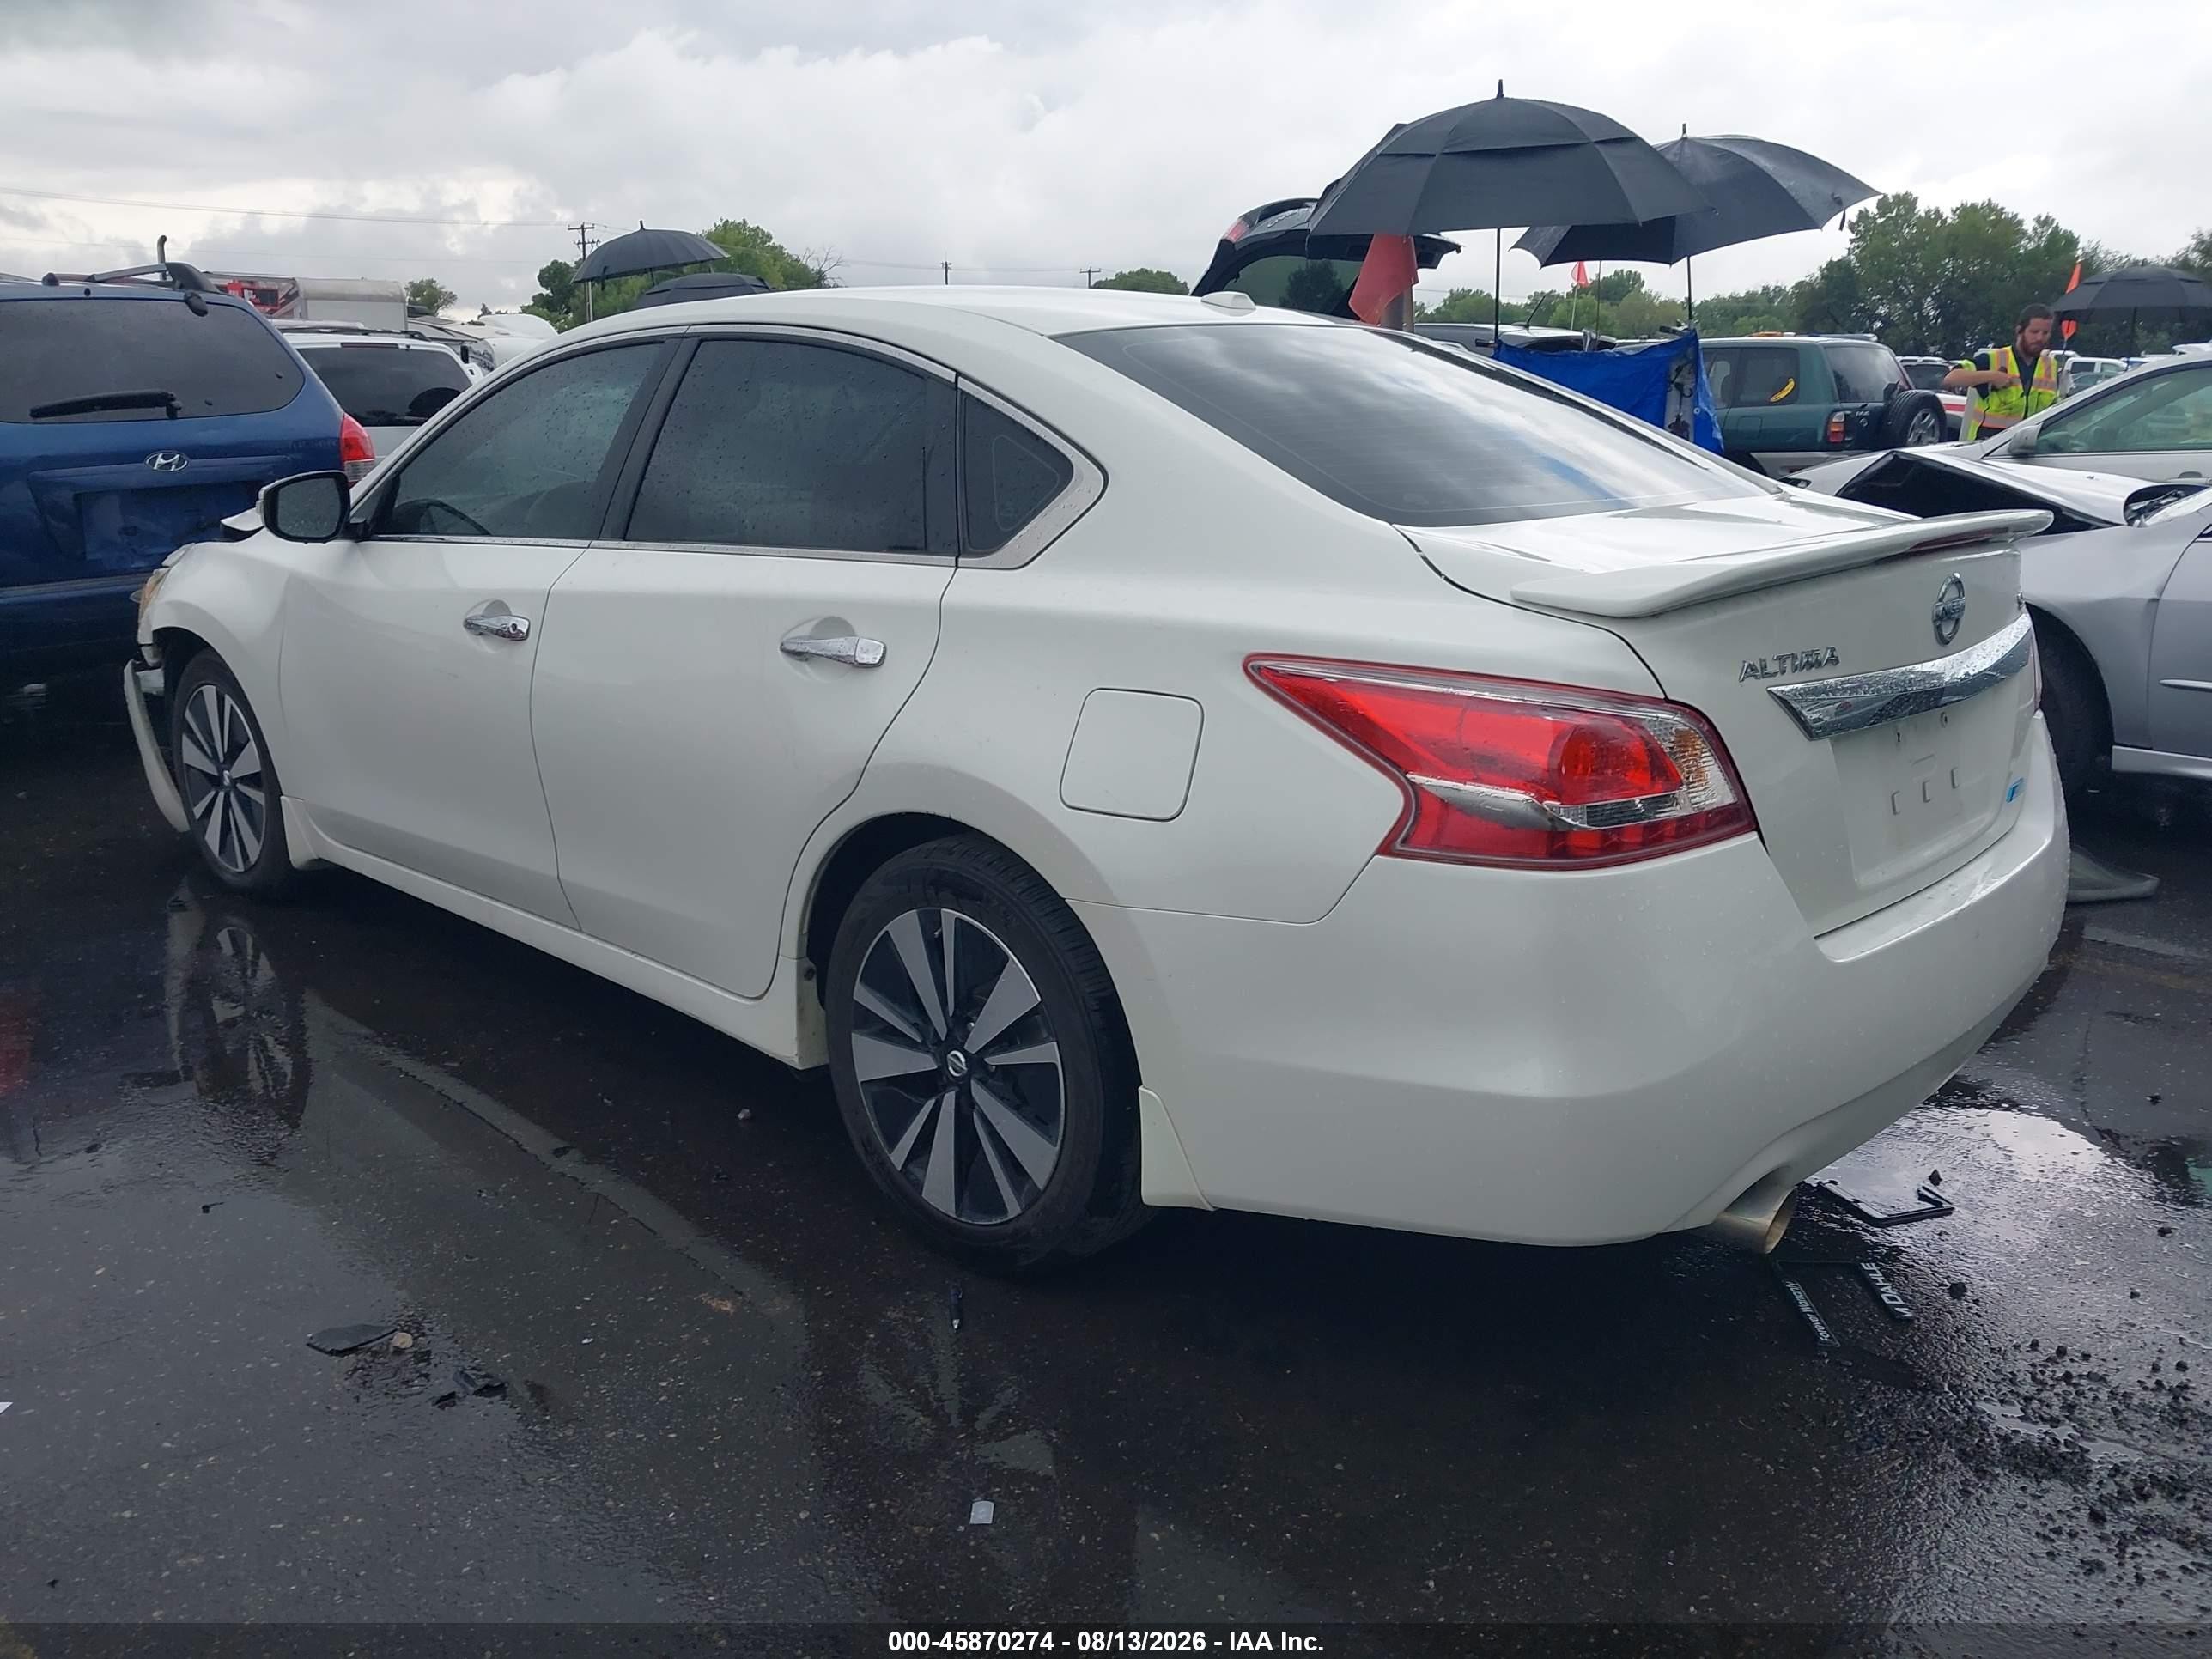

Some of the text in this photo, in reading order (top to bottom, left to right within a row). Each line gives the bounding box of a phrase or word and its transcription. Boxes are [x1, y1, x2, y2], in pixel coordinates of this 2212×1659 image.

[1738, 646, 1840, 683] ALTIMA
[1860, 1262, 1905, 1304] DAHLE
[1785, 1280, 1833, 1341] Forever Warranty
